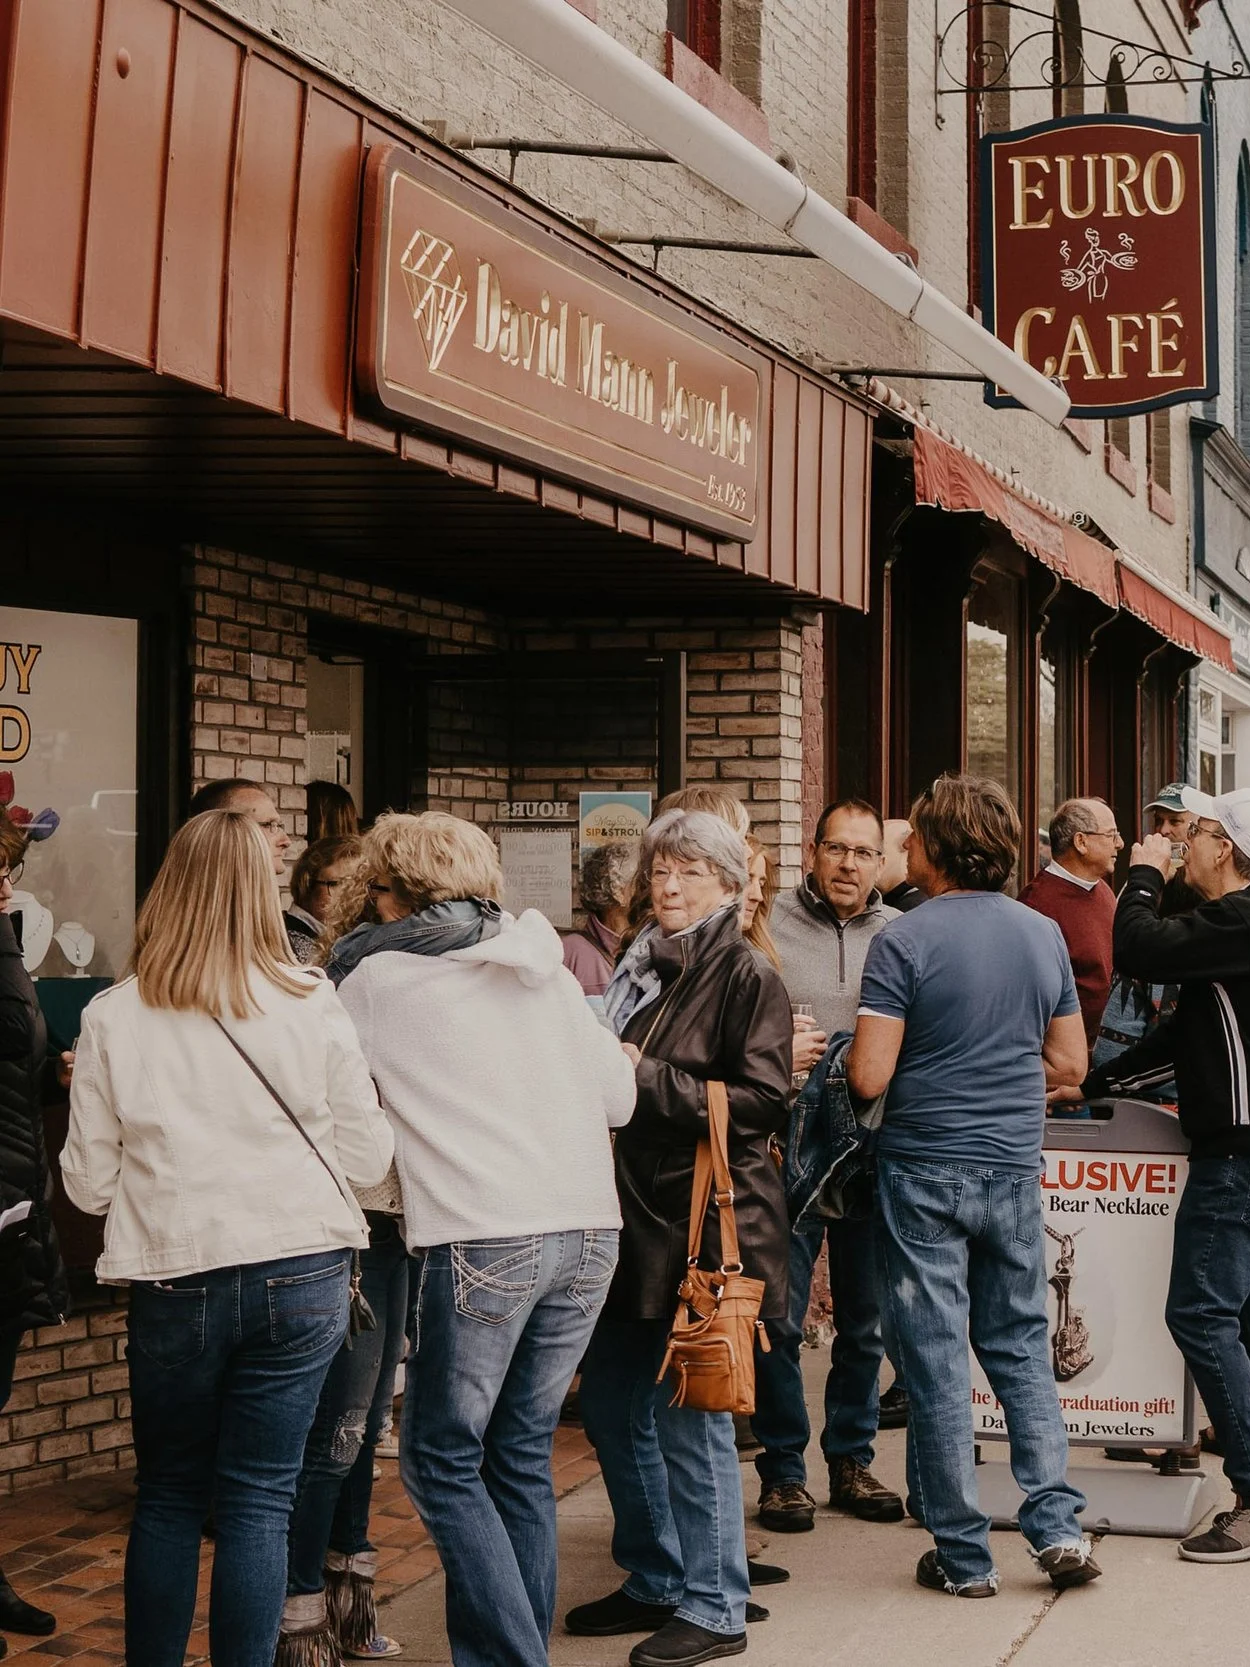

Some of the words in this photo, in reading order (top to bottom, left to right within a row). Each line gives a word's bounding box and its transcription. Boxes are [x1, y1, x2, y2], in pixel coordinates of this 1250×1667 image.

[1008, 150, 1186, 230] EURO
[1014, 297, 1187, 381] CAFÉ
[473, 256, 569, 388] David
[576, 310, 655, 425] Mann
[661, 357, 751, 467] Jeweler
[1041, 1160, 1176, 1194] LUSIVE!
[1049, 1195, 1089, 1213] Bear
[1094, 1197, 1170, 1216] Necklace
[971, 1388, 991, 1405] he
[1144, 1397, 1175, 1418] gift!
[1082, 1420, 1155, 1437] Jewelers
